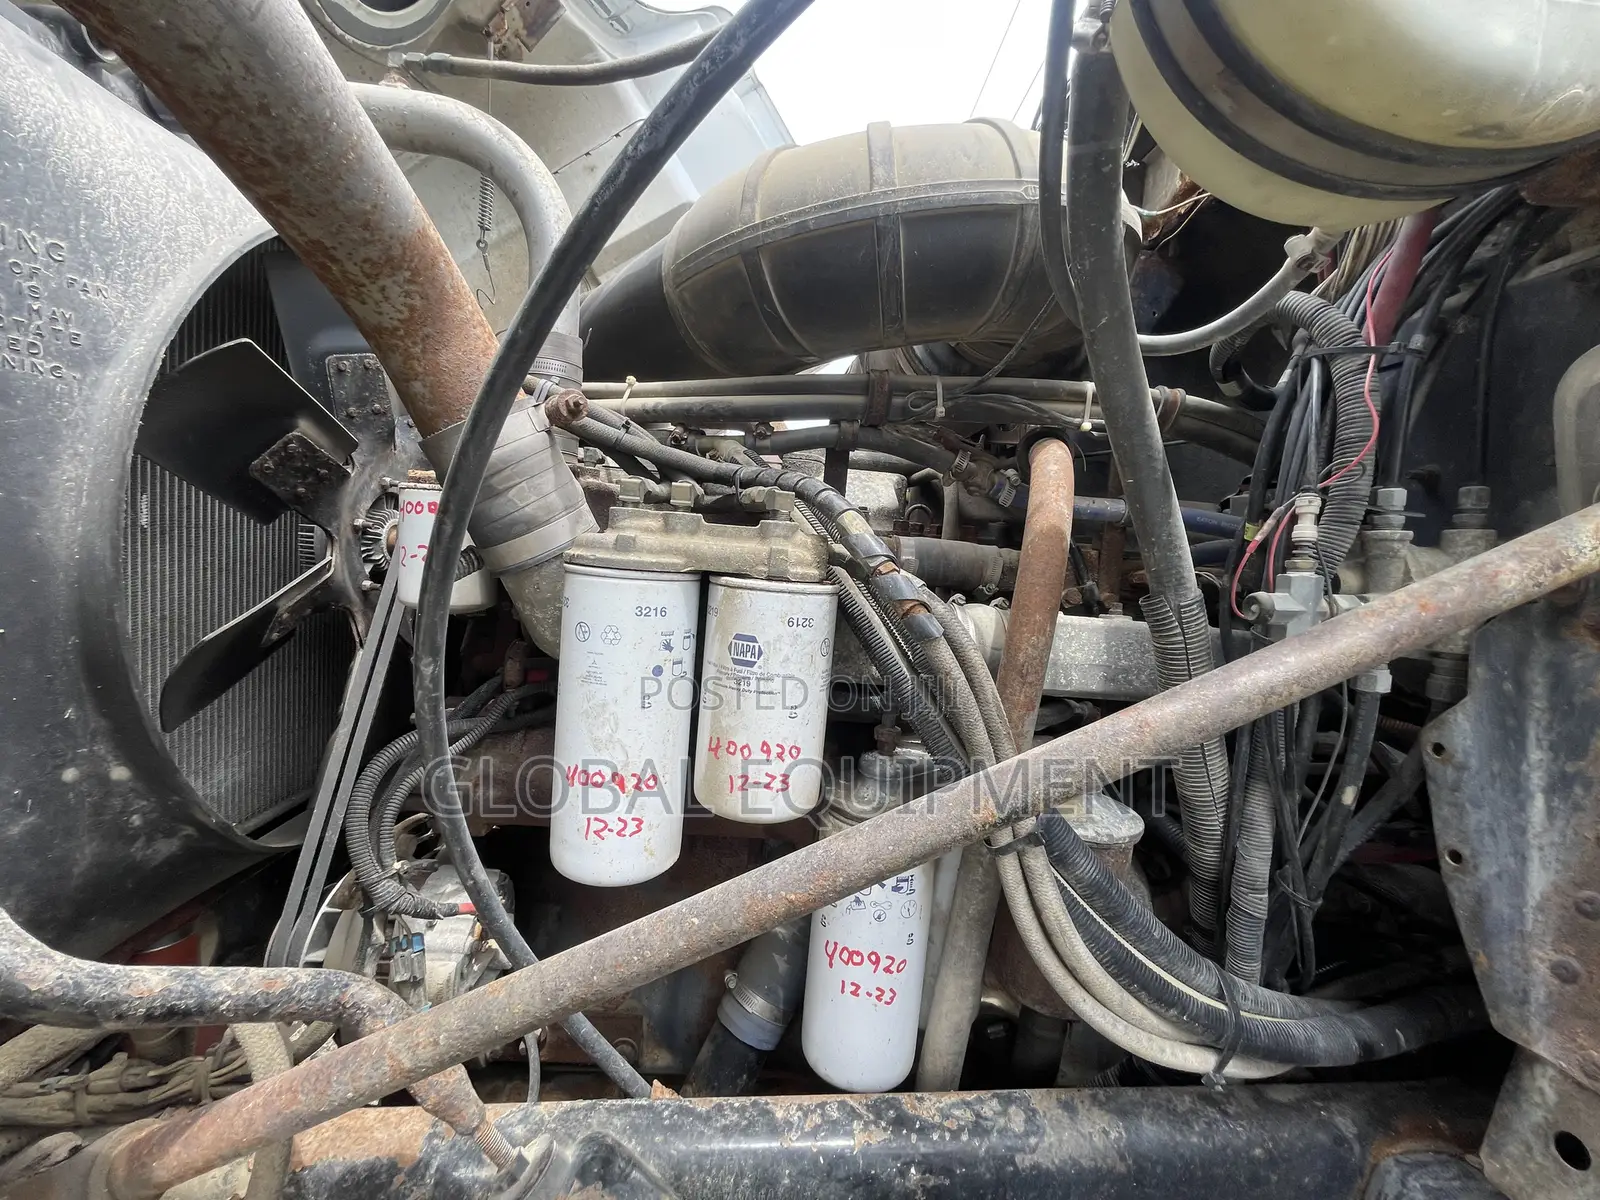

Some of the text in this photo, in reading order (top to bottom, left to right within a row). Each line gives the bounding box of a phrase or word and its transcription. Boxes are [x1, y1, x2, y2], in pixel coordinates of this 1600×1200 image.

[635, 606, 667, 617] 3216
[787, 617, 815, 629] 3219
[732, 641, 757, 660] NAPA
[733, 679, 751, 687] 3219
[729, 772, 790, 793] 12-23
